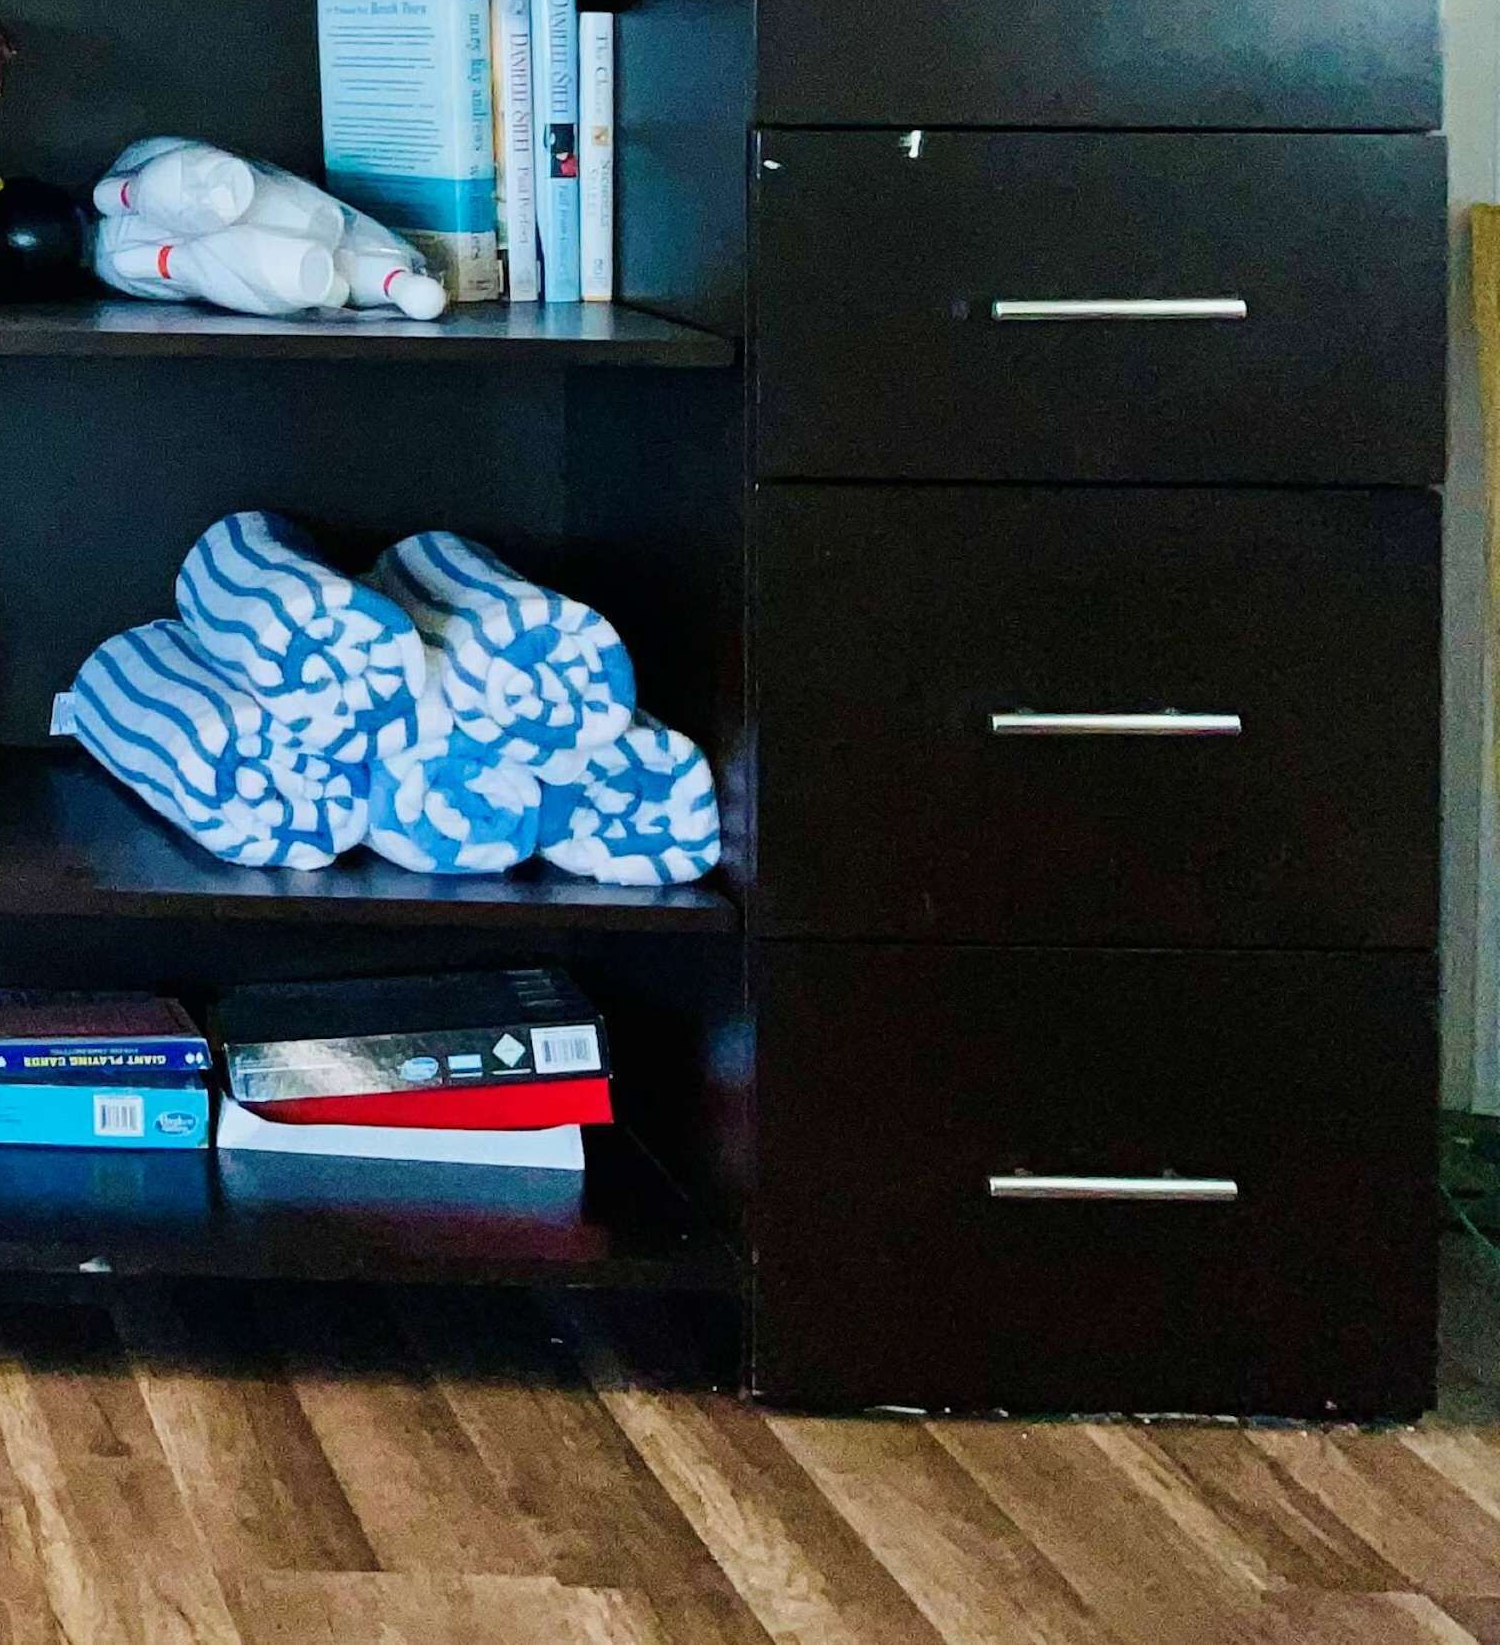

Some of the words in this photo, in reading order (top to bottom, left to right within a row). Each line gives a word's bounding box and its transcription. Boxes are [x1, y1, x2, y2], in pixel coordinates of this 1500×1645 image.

[509, 32, 529, 102] DANIELLE
[550, 70, 573, 114] STEEL
[511, 110, 531, 153] STEEL
[23, 1056, 67, 1069] CARDS
[70, 1055, 124, 1068] PLAYING
[126, 1054, 167, 1066] GIANT
